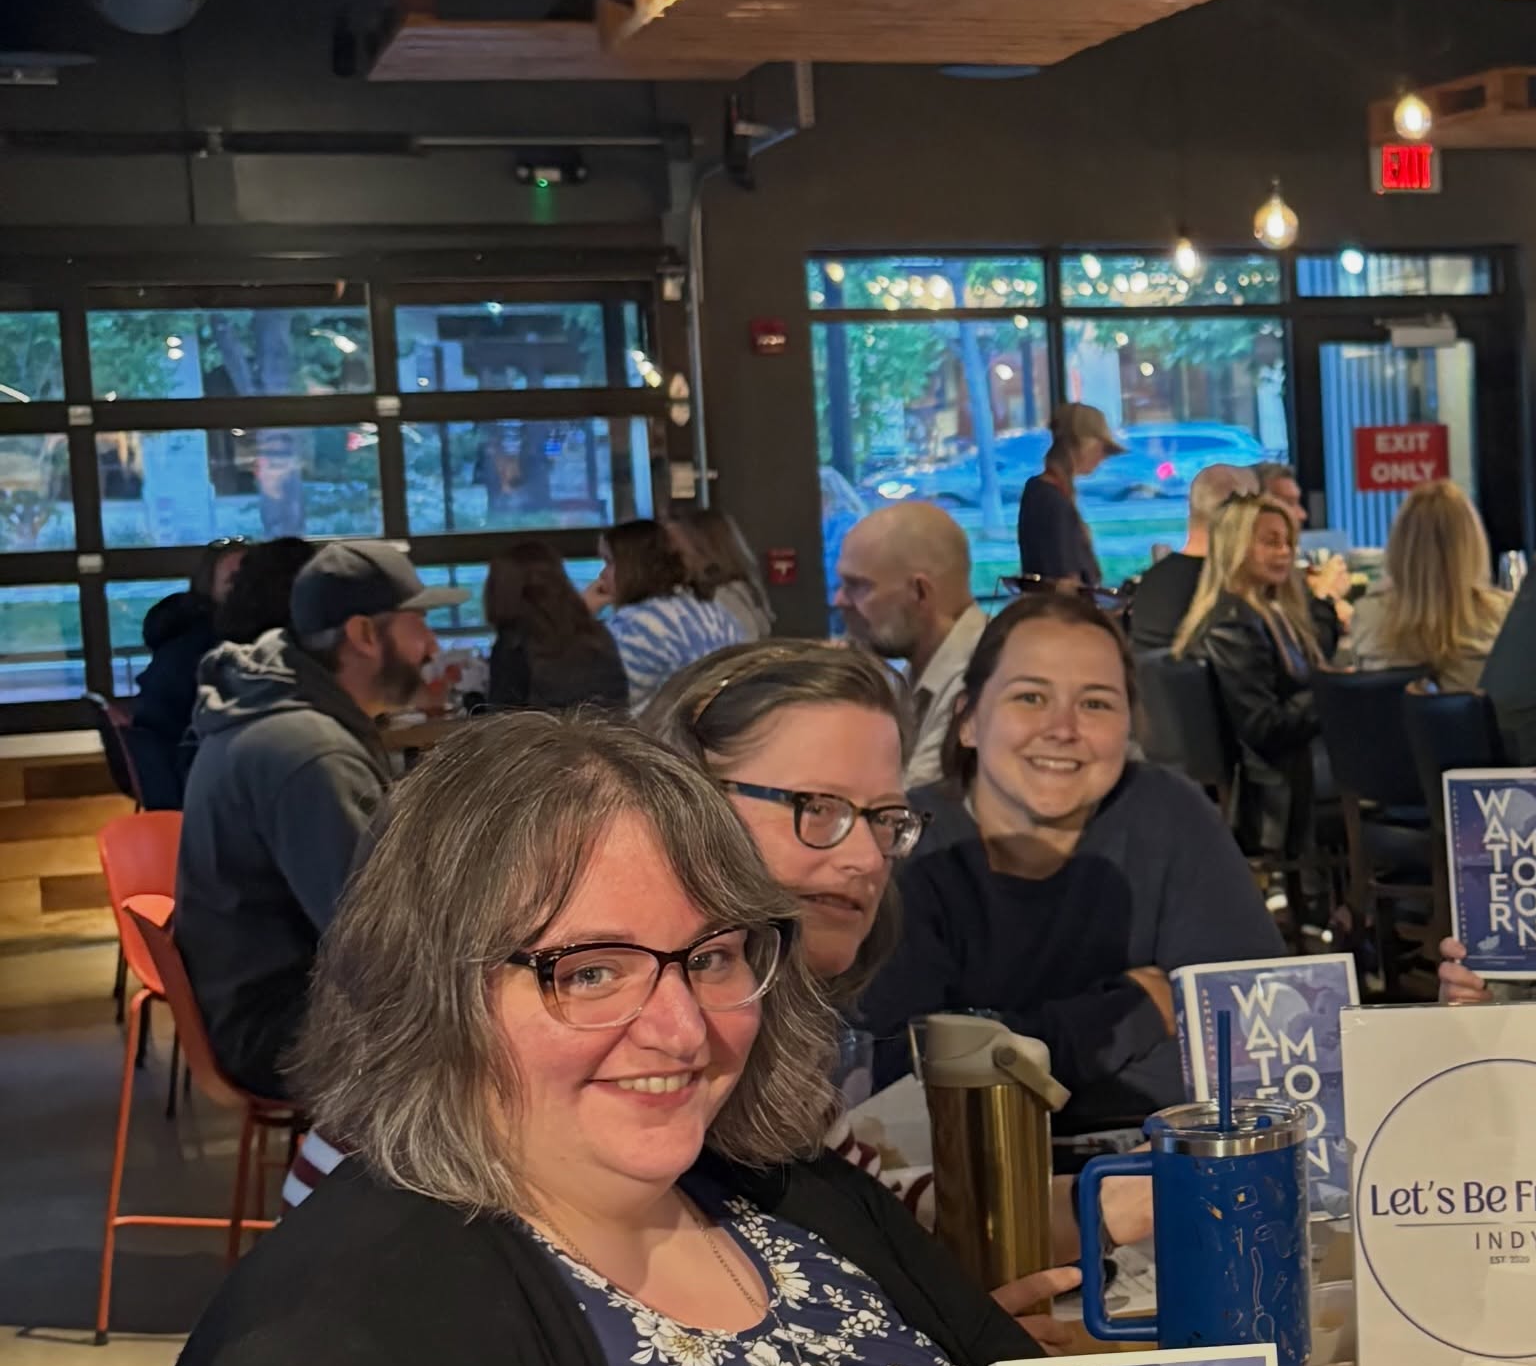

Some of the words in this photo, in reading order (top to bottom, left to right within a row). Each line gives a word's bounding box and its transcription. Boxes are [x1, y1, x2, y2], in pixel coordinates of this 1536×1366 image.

[1375, 433, 1430, 454] EXIT
[1371, 461, 1436, 484] ONLY
[1473, 789, 1514, 932] WATER
[1370, 1180, 1455, 1216] Let's
[1463, 1181, 1507, 1213] Be
